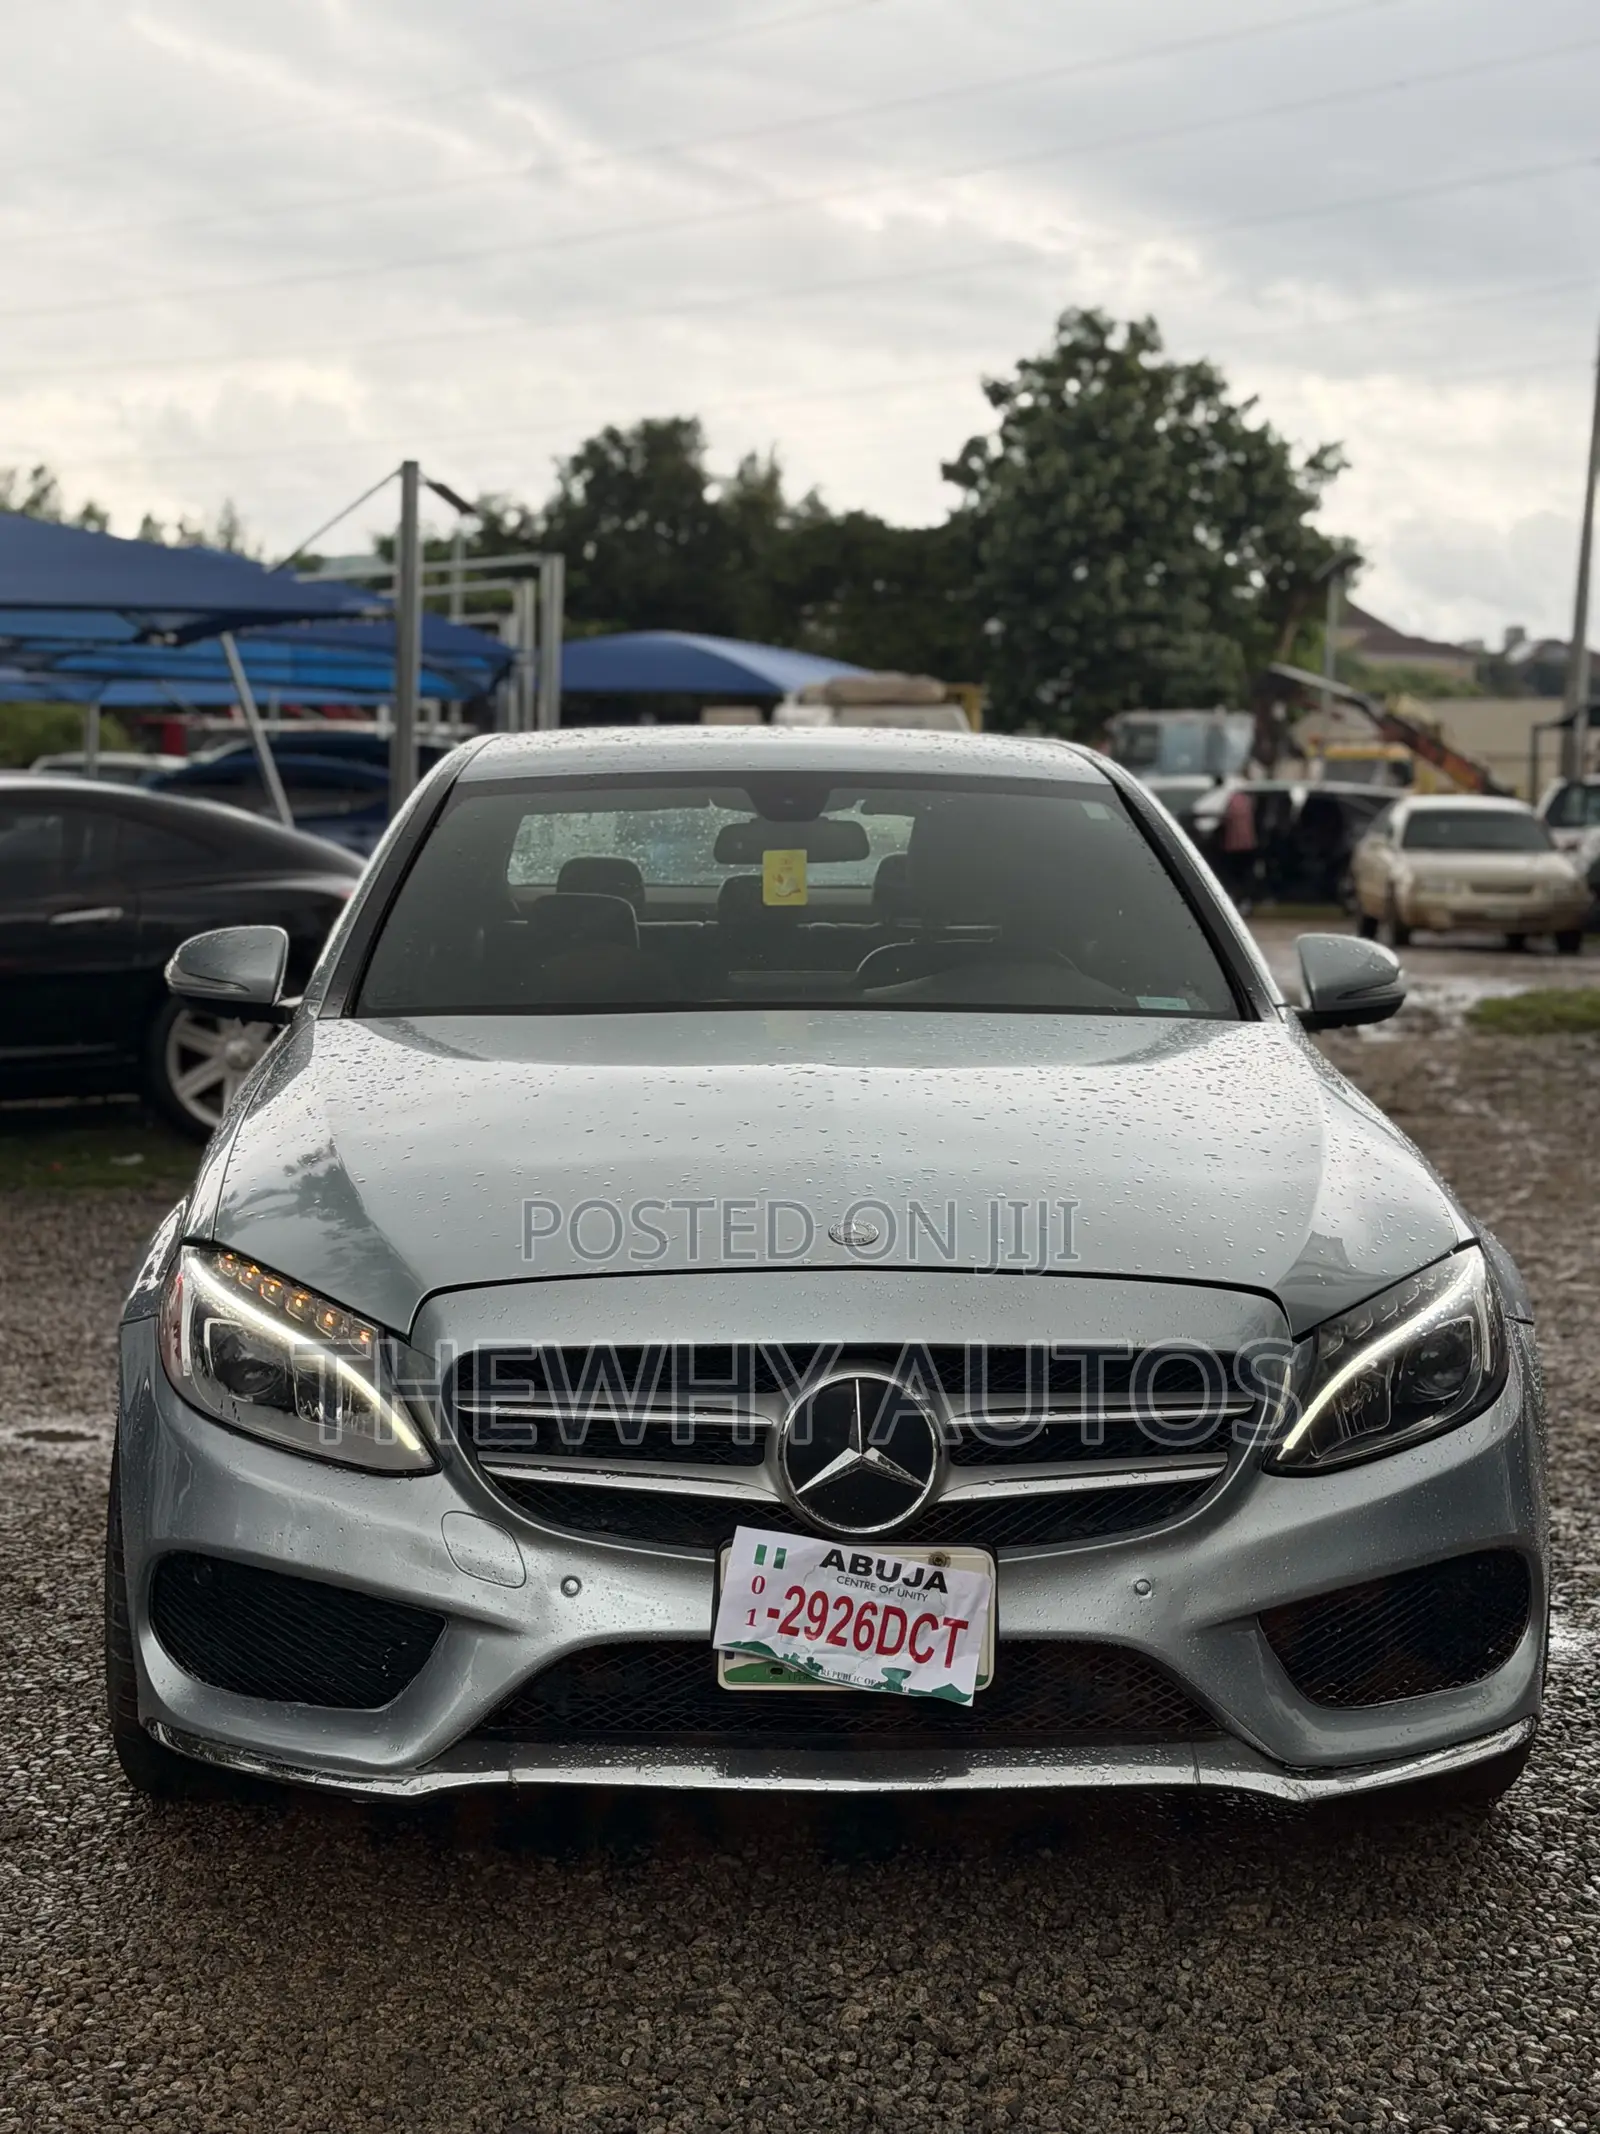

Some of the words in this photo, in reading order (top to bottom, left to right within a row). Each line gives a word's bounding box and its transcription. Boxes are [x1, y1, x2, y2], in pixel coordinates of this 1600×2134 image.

[819, 1548, 948, 1594] ABUJA
[836, 1575, 876, 1592] CENTRE
[879, 1585, 894, 1595] OF
[897, 1588, 928, 1602] UNITY
